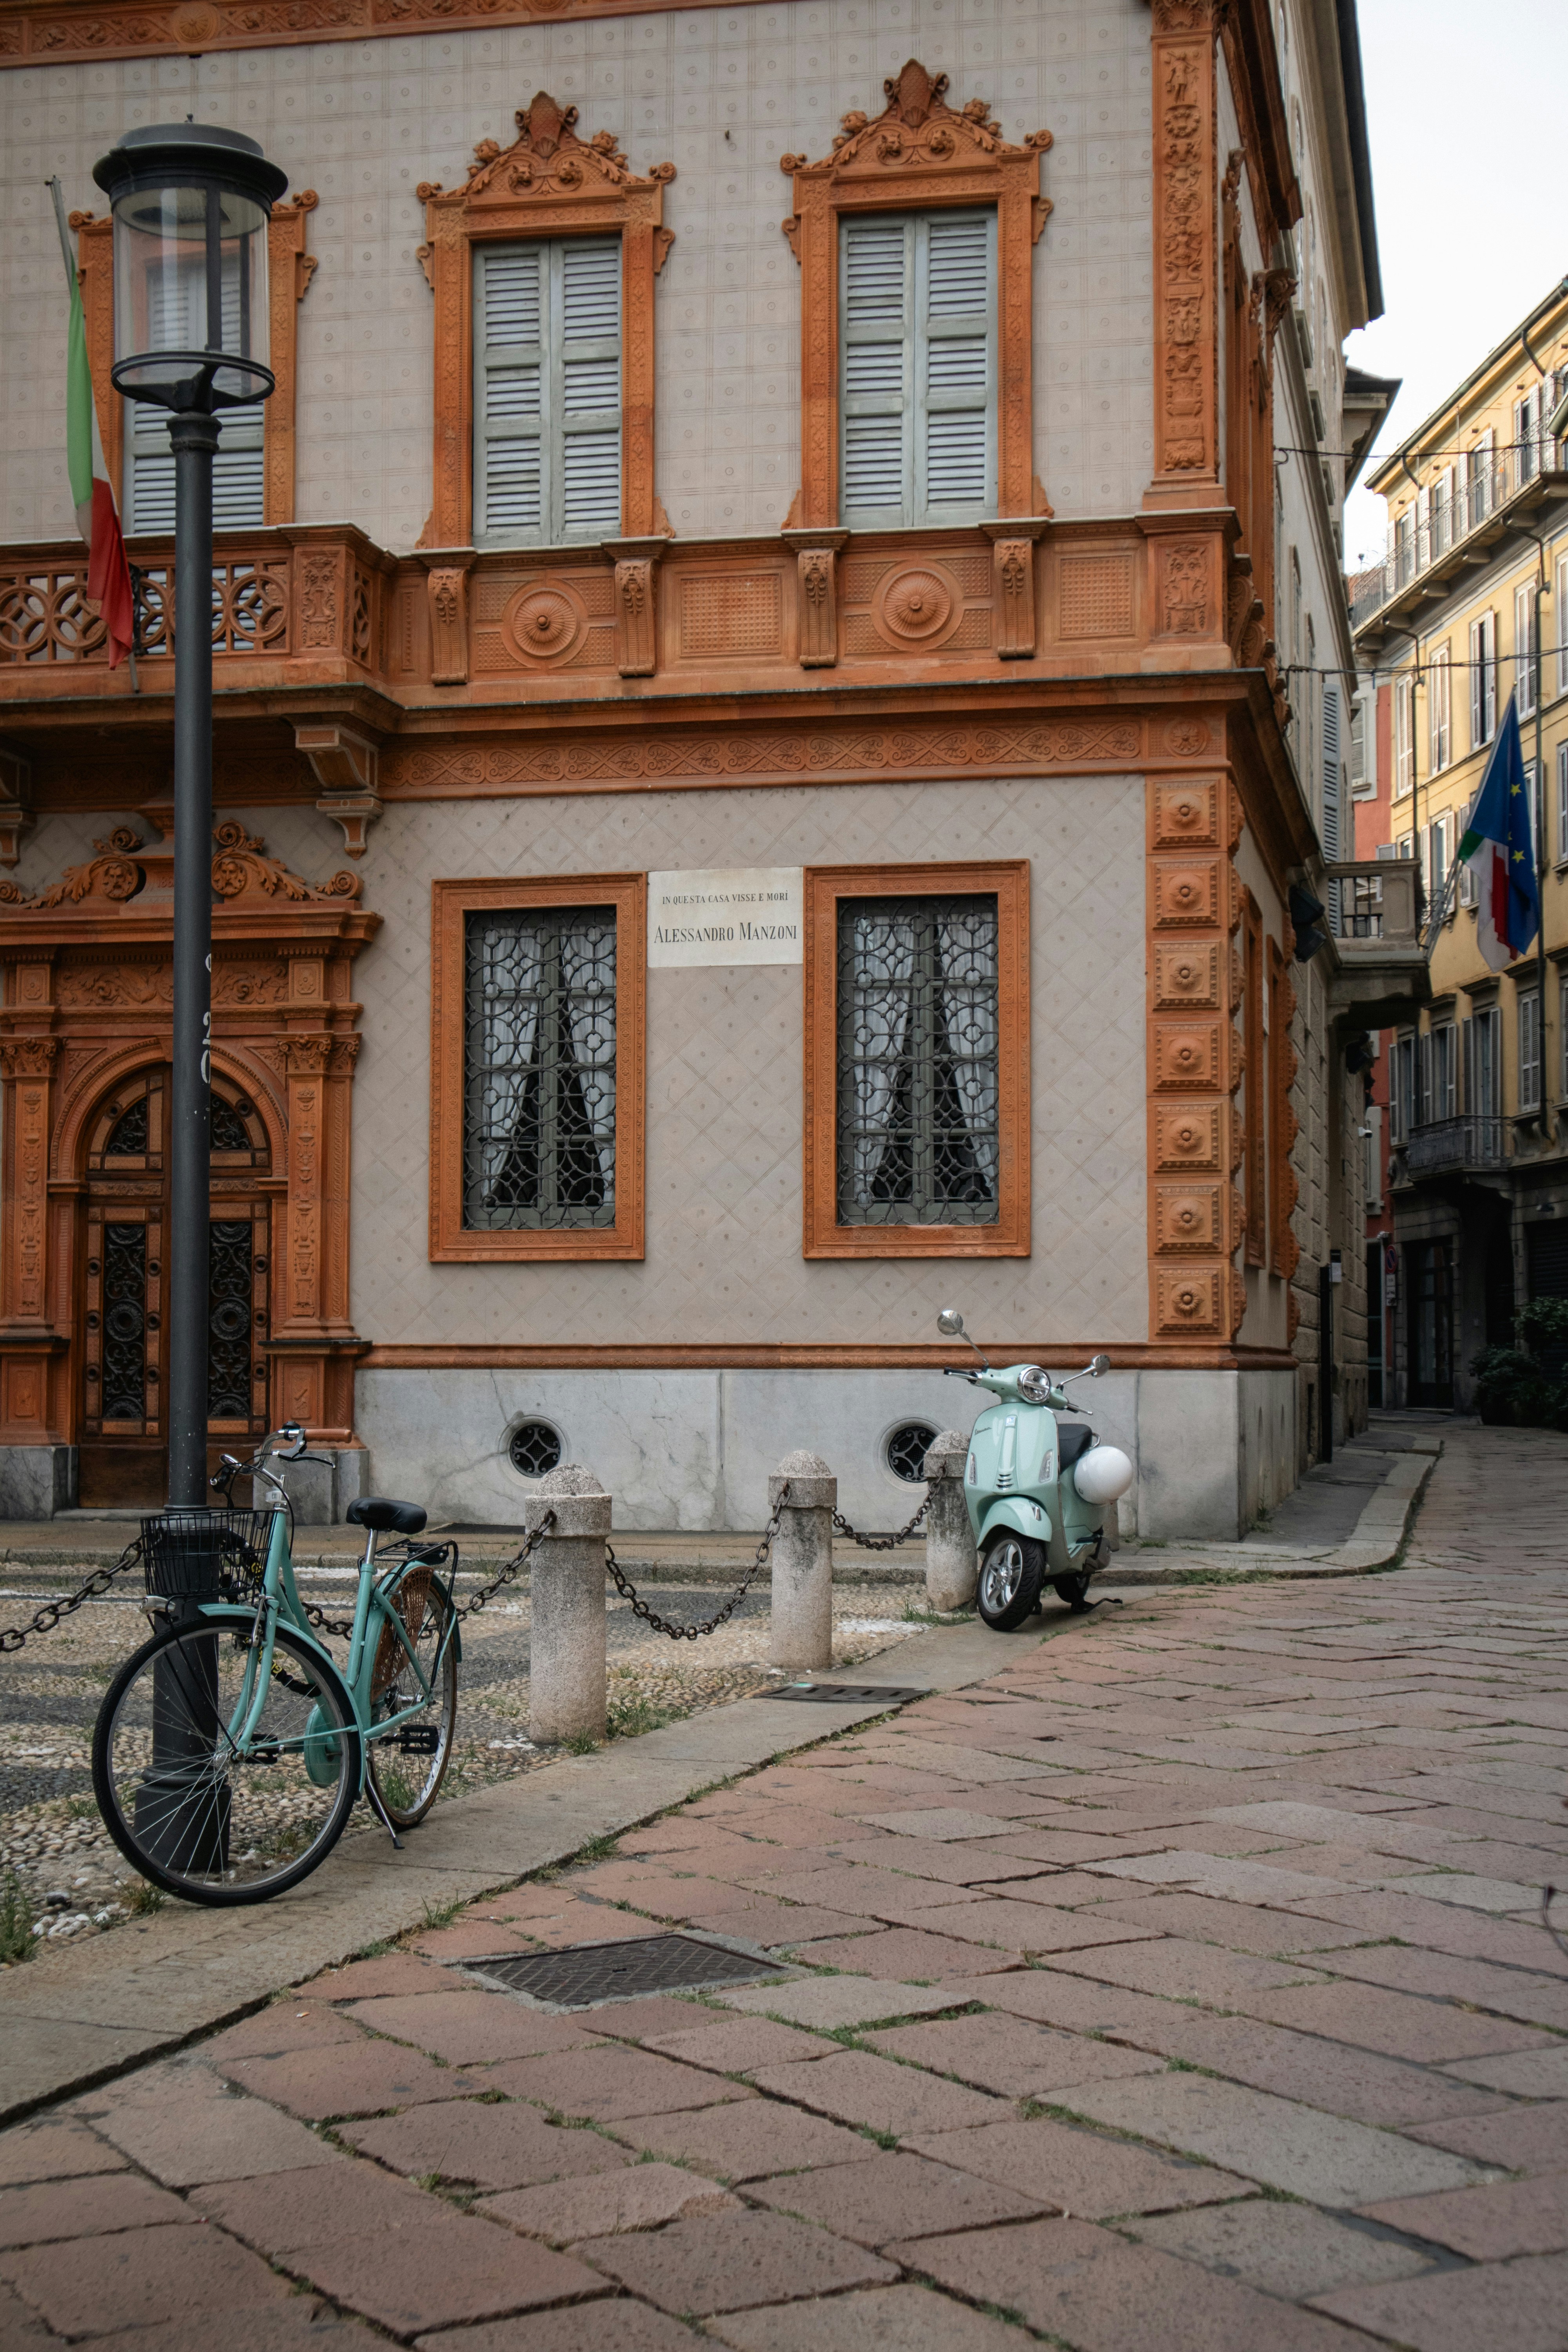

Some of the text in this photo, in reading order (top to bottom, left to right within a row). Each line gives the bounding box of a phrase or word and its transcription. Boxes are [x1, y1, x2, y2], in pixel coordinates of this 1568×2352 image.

[662, 896, 671, 904] IN
[673, 895, 706, 905] QUESTA
[708, 894, 730, 903] CASA
[732, 893, 756, 902] VISSE
[759, 893, 764, 901] E
[654, 922, 797, 943] ALESSANDRO MANZONI
